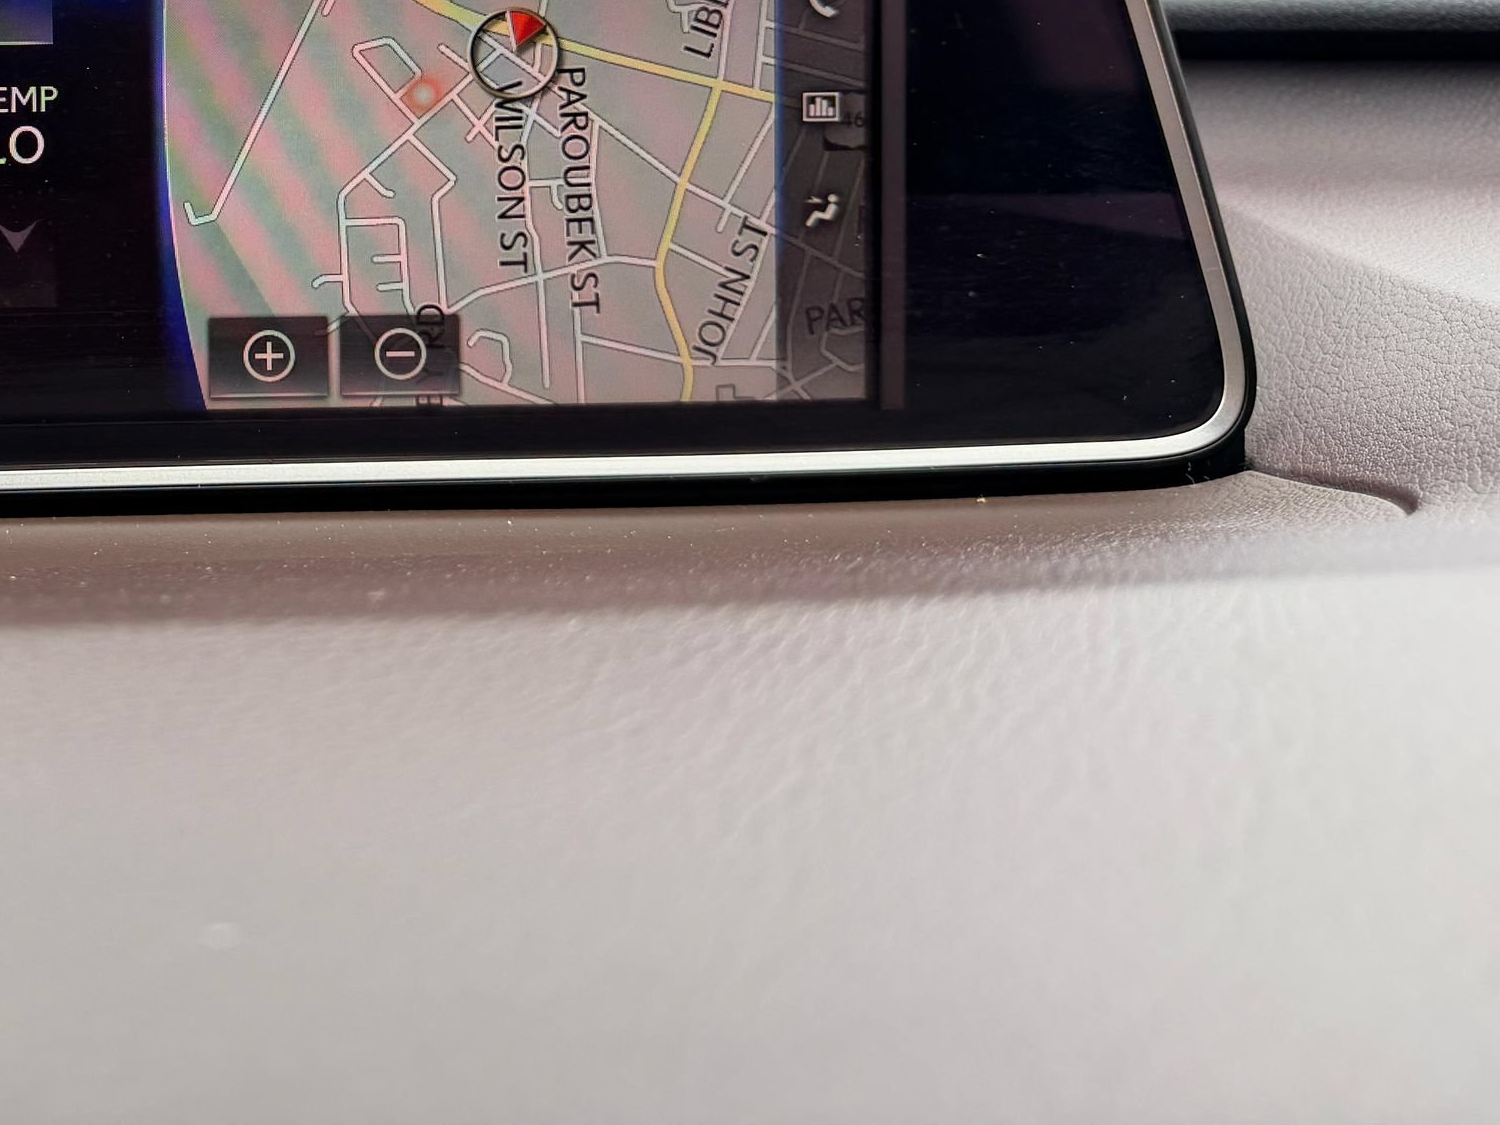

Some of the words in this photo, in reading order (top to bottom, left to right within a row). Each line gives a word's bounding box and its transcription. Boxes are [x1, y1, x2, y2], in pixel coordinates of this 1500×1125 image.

[558, 66, 597, 264] PAROUBEK
[499, 231, 529, 273] ST
[571, 271, 600, 315] ST
[692, 266, 752, 367] JOHN
[731, 216, 769, 264] ST
